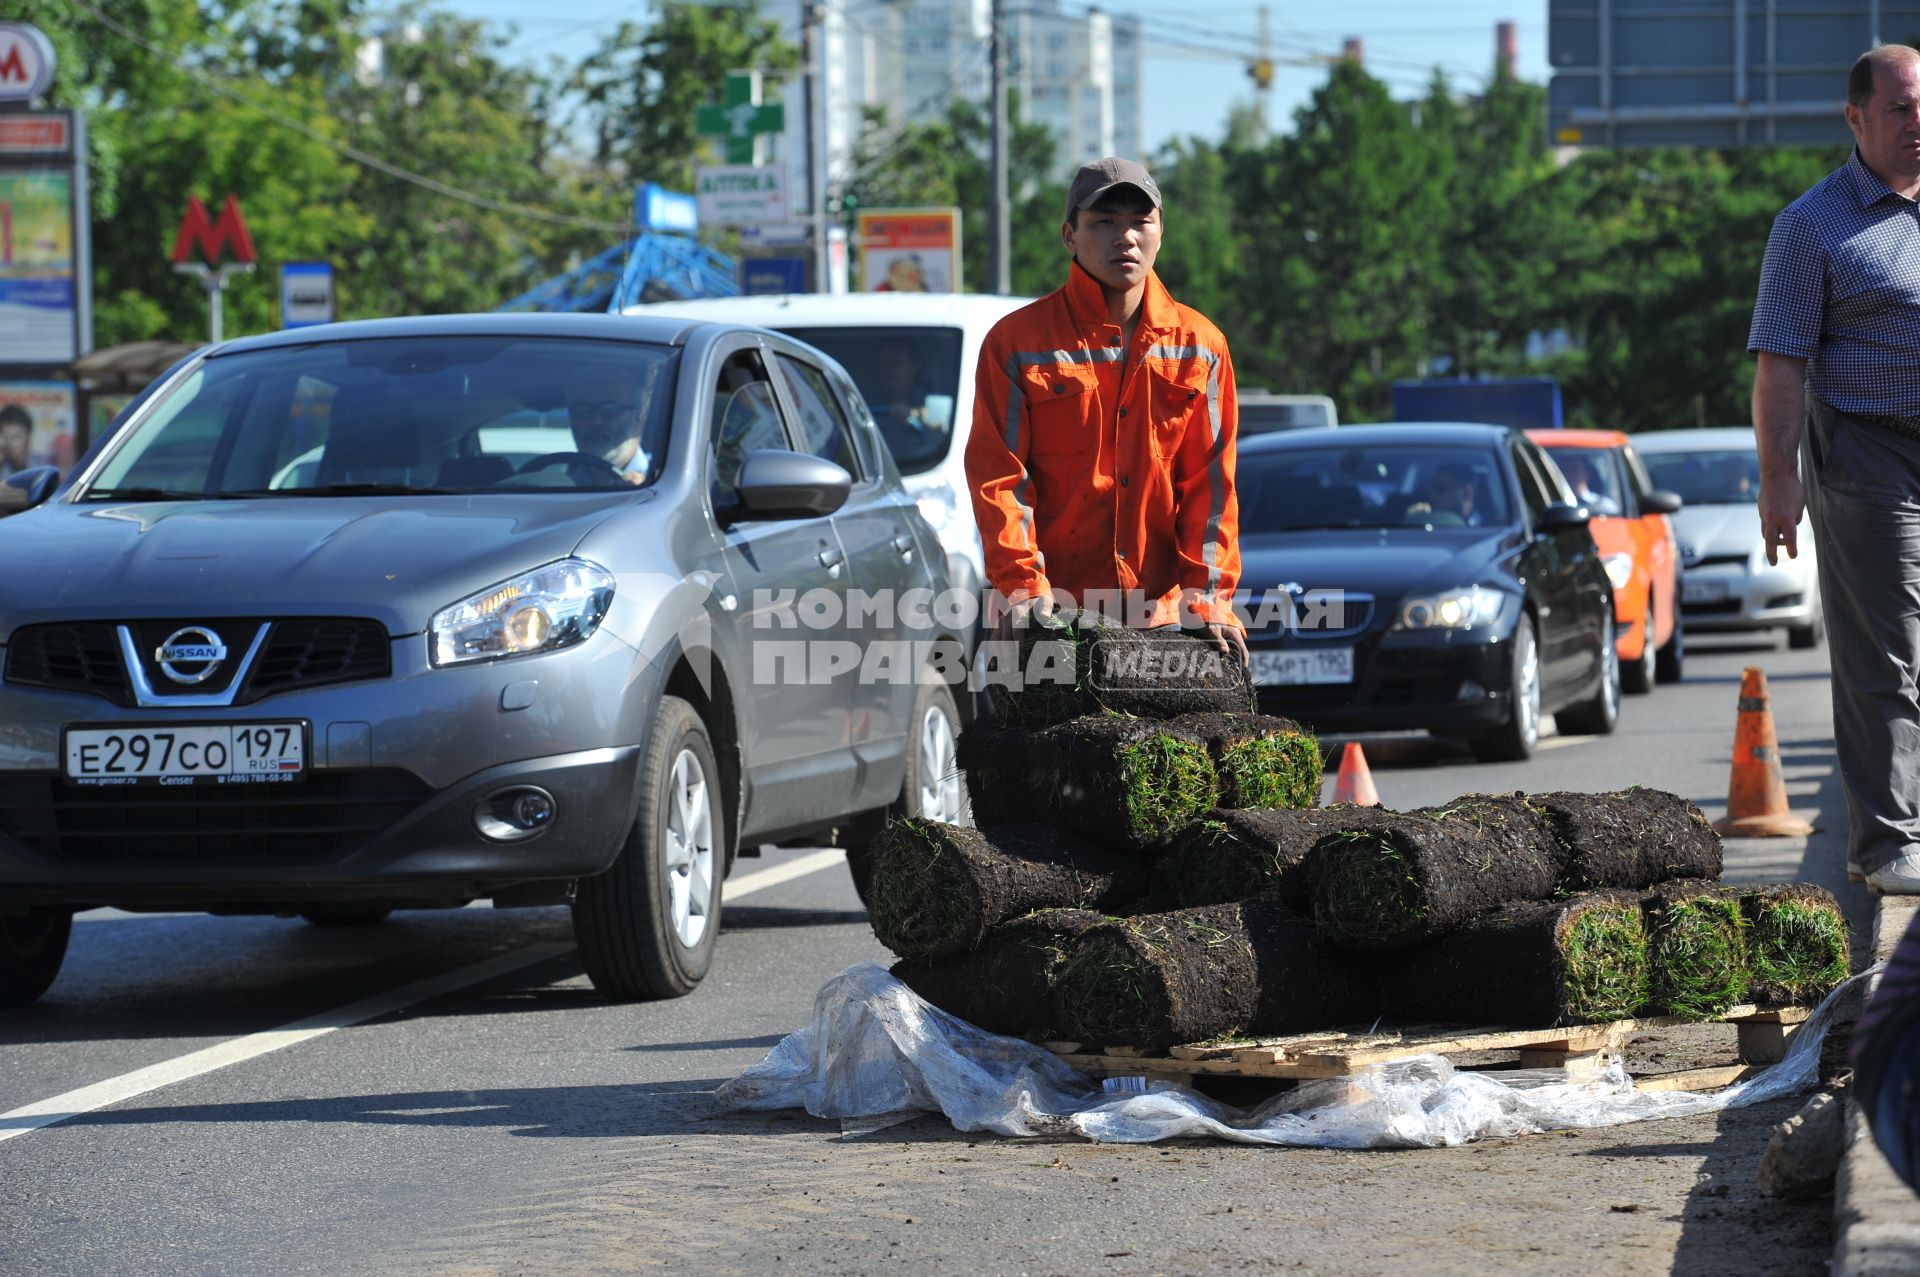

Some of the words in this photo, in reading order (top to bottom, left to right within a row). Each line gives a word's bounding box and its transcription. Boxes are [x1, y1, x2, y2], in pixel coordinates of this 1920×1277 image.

[171, 193, 257, 265] М
[162, 648, 218, 658] NISSAN
[1318, 650, 1347, 672] 190
[80, 734, 227, 773] Е297СО
[236, 728, 291, 757] 197
[250, 759, 277, 770] RUS
[77, 776, 138, 787] www.genser.ru
